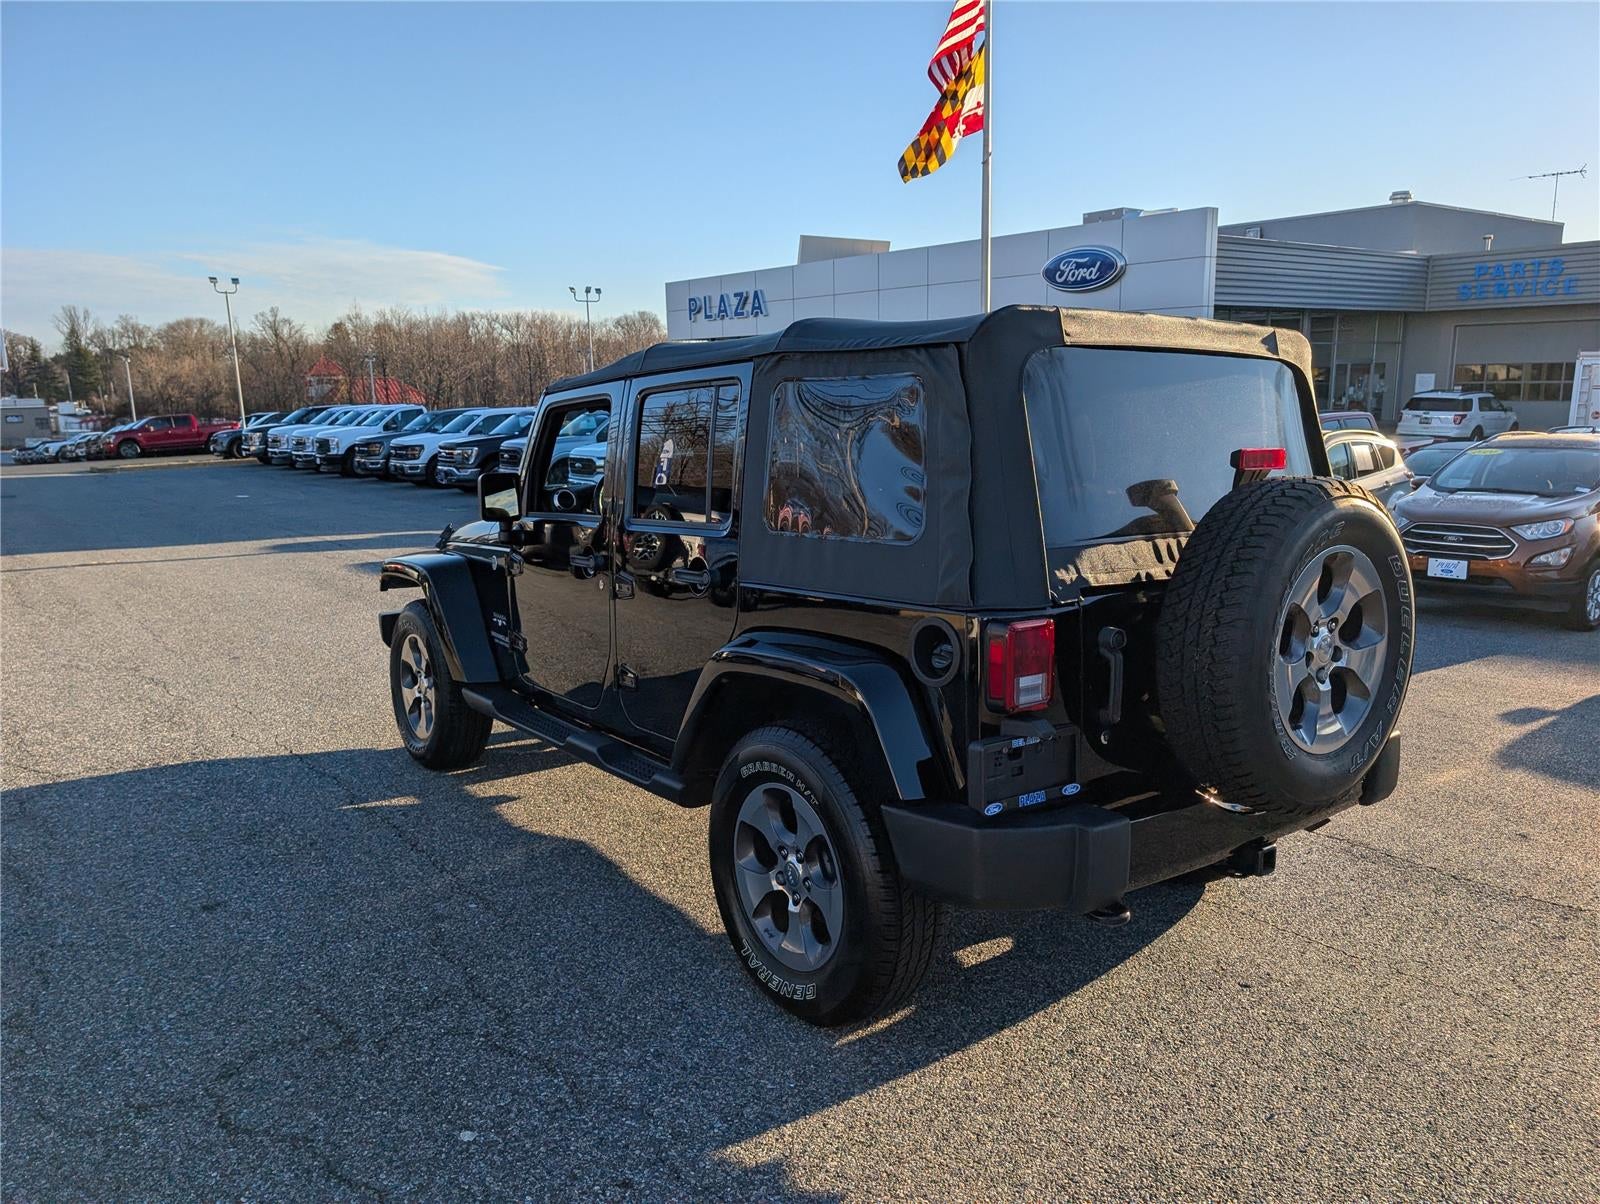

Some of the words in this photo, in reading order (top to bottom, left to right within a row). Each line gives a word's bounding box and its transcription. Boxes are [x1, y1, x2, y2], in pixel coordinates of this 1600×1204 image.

[1056, 257, 1102, 283] Ford
[1474, 258, 1565, 279] PARTS
[1457, 277, 1579, 299] SERVICE
[688, 290, 764, 321] PLAZA
[1387, 555, 1411, 714] DUELER
[1350, 720, 1383, 773] A/T
[740, 761, 795, 781] GRABBER
[796, 779, 819, 807] H/T
[1019, 790, 1046, 807] PLAZA
[740, 938, 817, 1000] GENERAL
